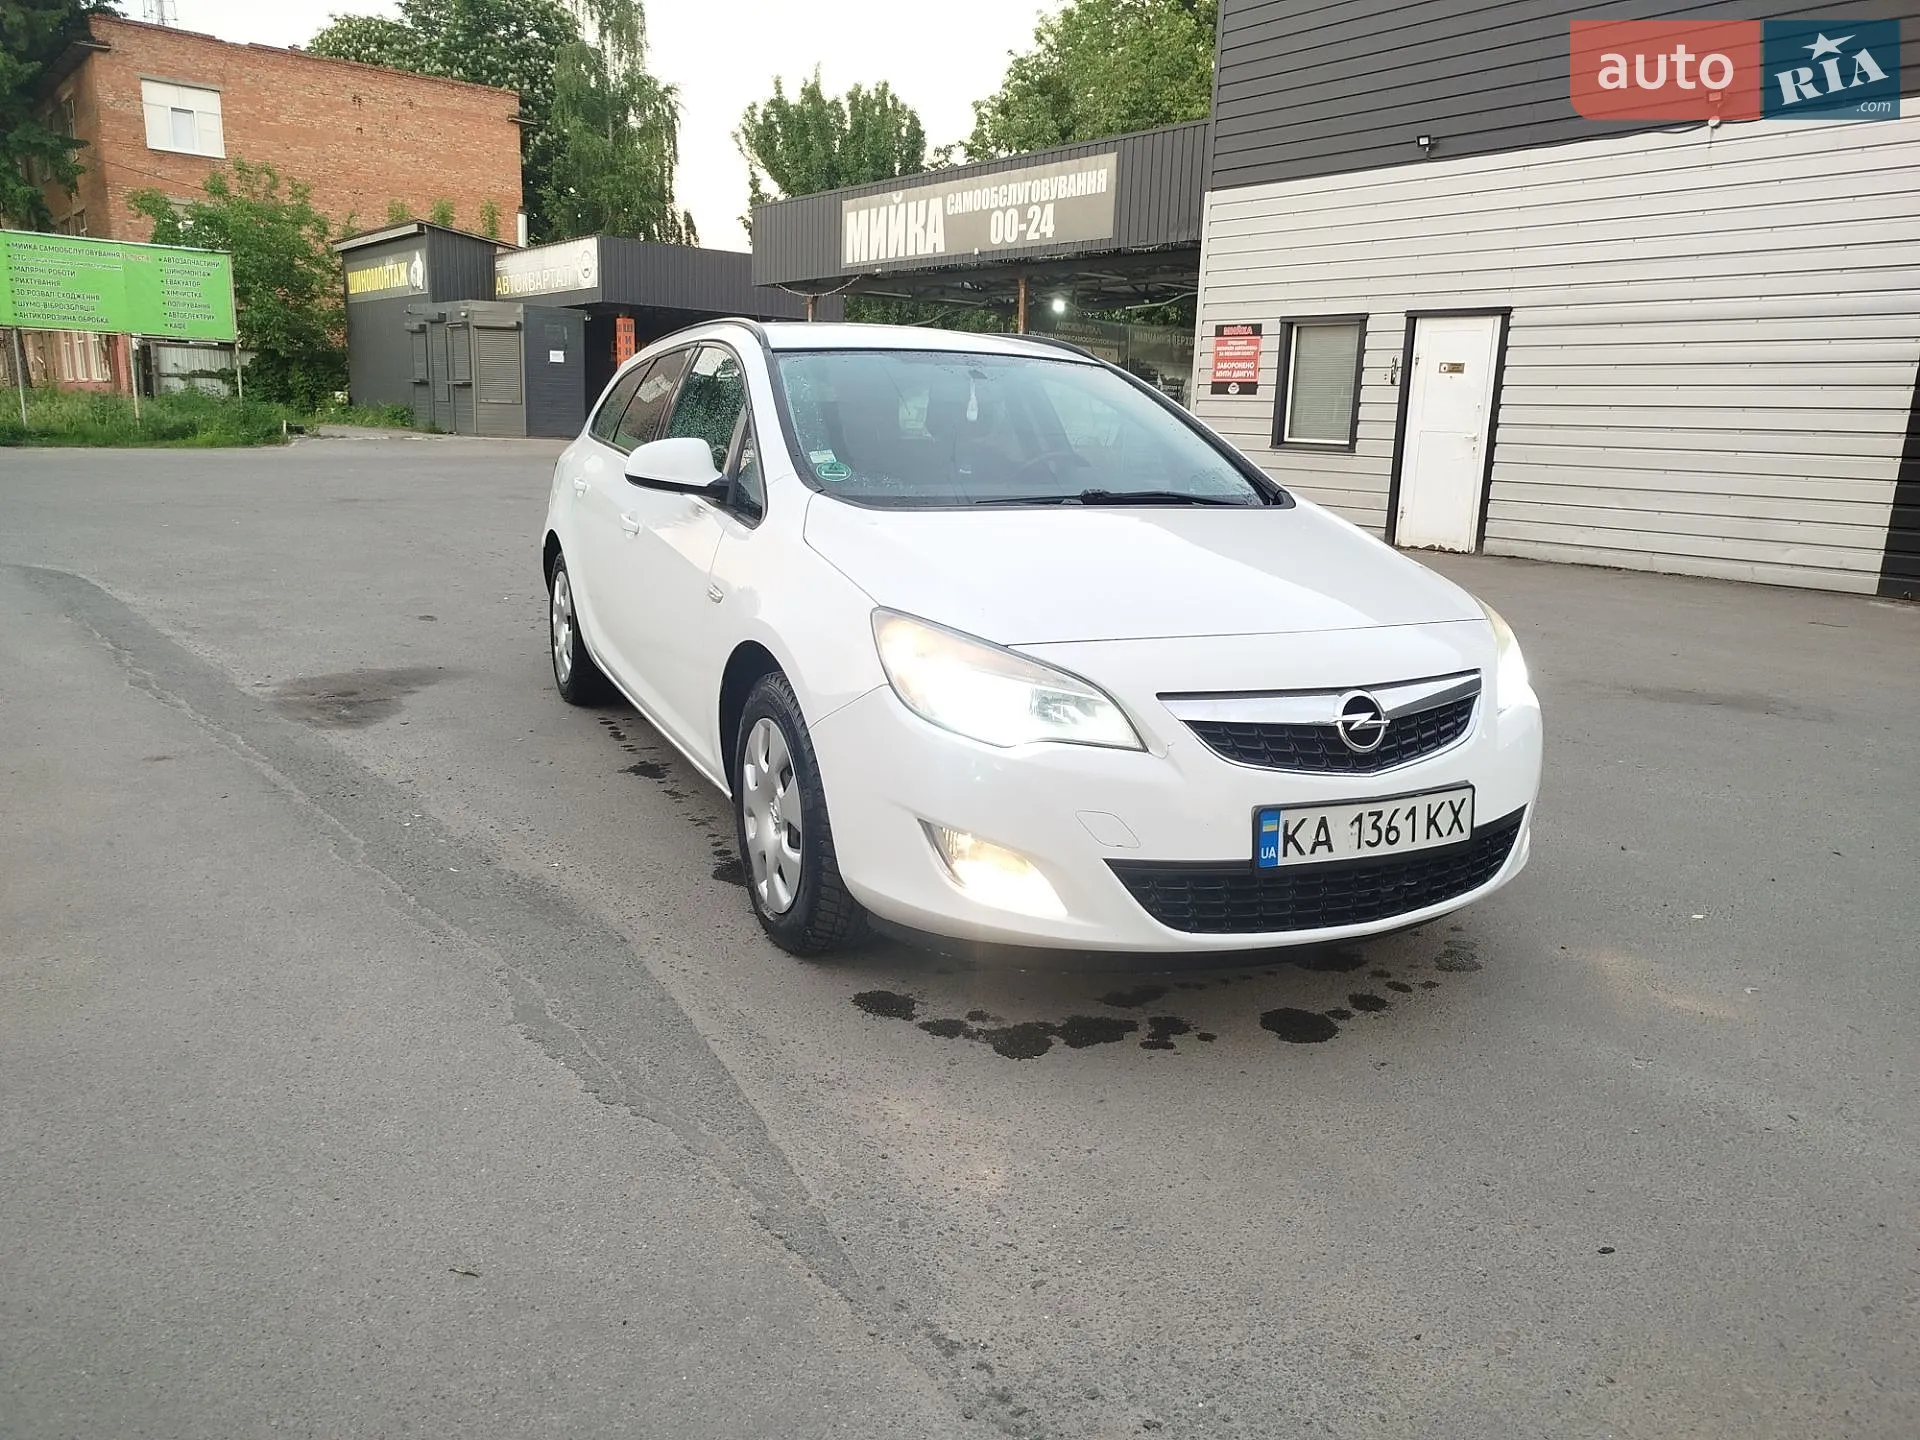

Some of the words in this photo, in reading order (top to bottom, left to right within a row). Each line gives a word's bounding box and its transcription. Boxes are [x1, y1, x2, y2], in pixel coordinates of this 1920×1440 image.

[946, 168, 1108, 216] САМООБСЛУГОВУВАННЯ
[846, 192, 946, 264] МИЙКА
[989, 203, 1055, 246] 00-24
[163, 257, 221, 268] АВТОЗАПЧАСТИНИ
[347, 261, 409, 296] ШИНОМОНТАЖ
[495, 266, 573, 296] АВТОКВАРТАЛ
[1217, 361, 1255, 369] ЗАБОРОНЕНО
[1260, 846, 1277, 860] UA
[1282, 816, 1335, 858] KA
